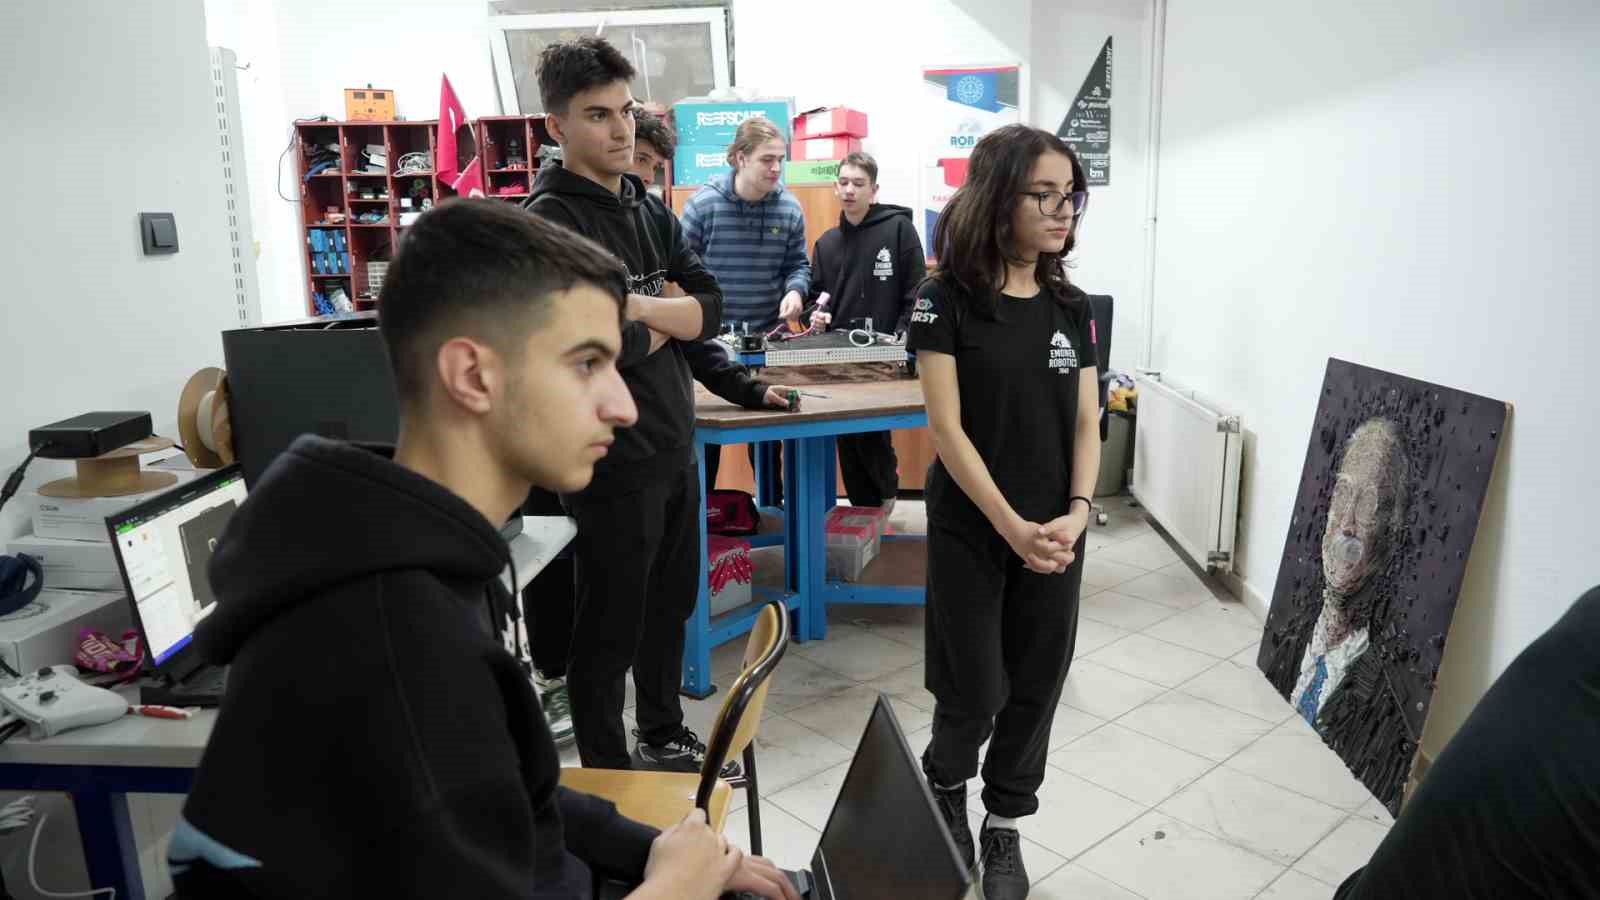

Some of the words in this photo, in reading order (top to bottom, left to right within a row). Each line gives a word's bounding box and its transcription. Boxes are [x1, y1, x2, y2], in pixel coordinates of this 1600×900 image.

[950, 135, 977, 146] ROB
[696, 153, 730, 168] REEF
[911, 311, 938, 324] IRST
